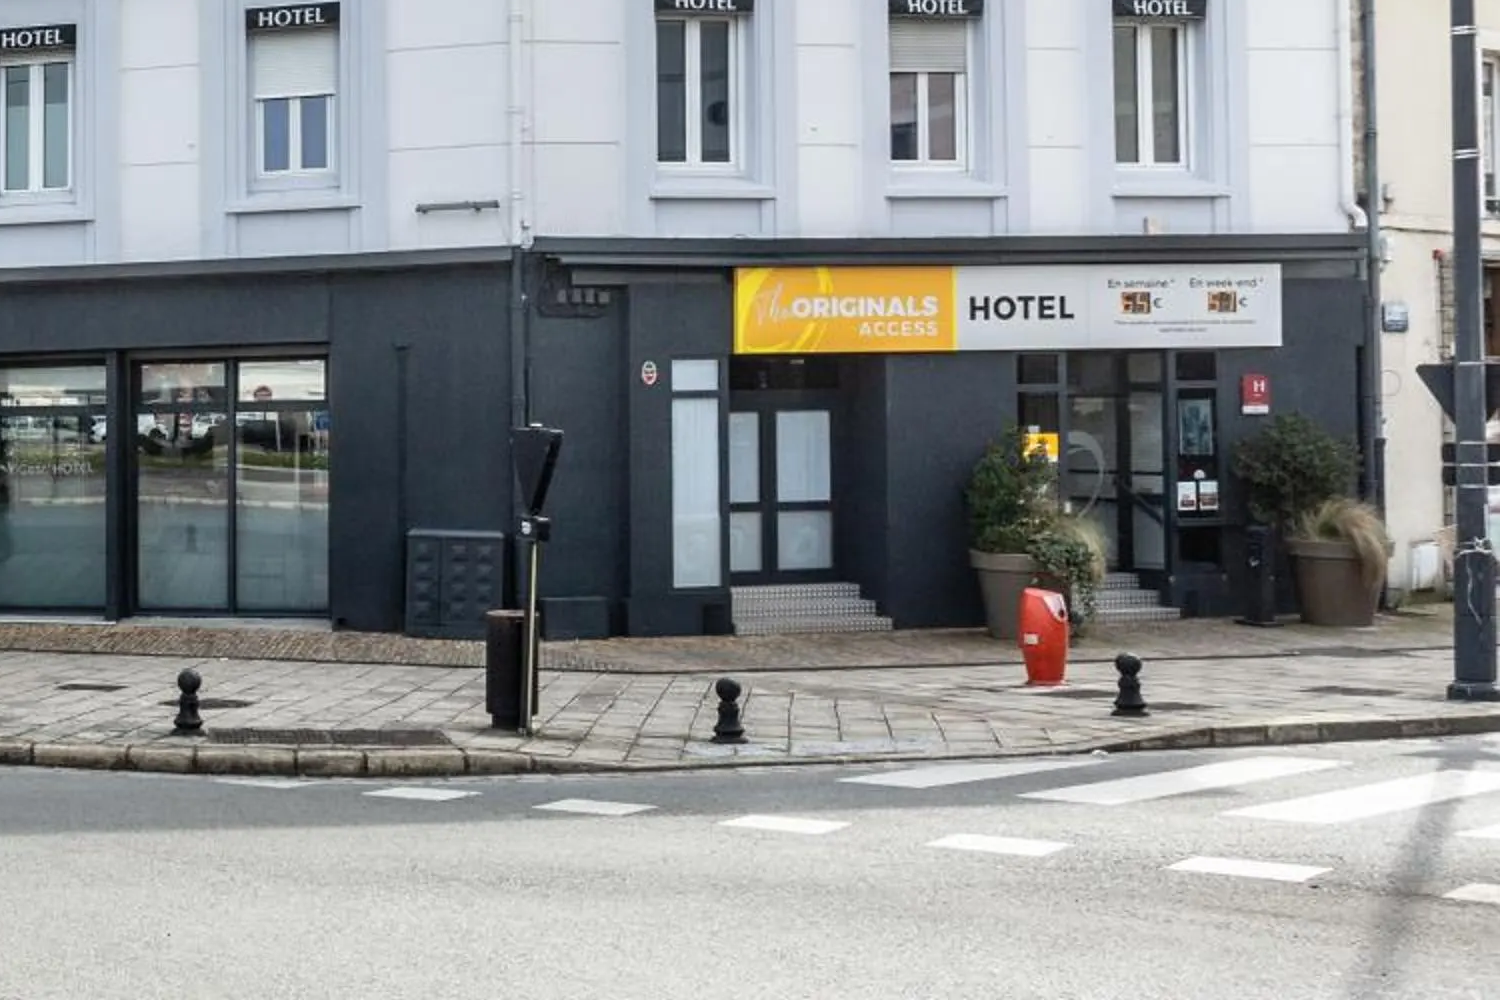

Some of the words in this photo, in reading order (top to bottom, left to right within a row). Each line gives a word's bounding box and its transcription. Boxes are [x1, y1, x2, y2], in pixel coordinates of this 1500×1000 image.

[258, 7, 325, 27] HOTEL
[1133, 0, 1193, 17] HOTEL
[1, 28, 63, 48] HOTEL
[792, 295, 940, 319] ORIGINALS
[968, 295, 1075, 321] HOTEL
[858, 320, 939, 337] ACCESS
